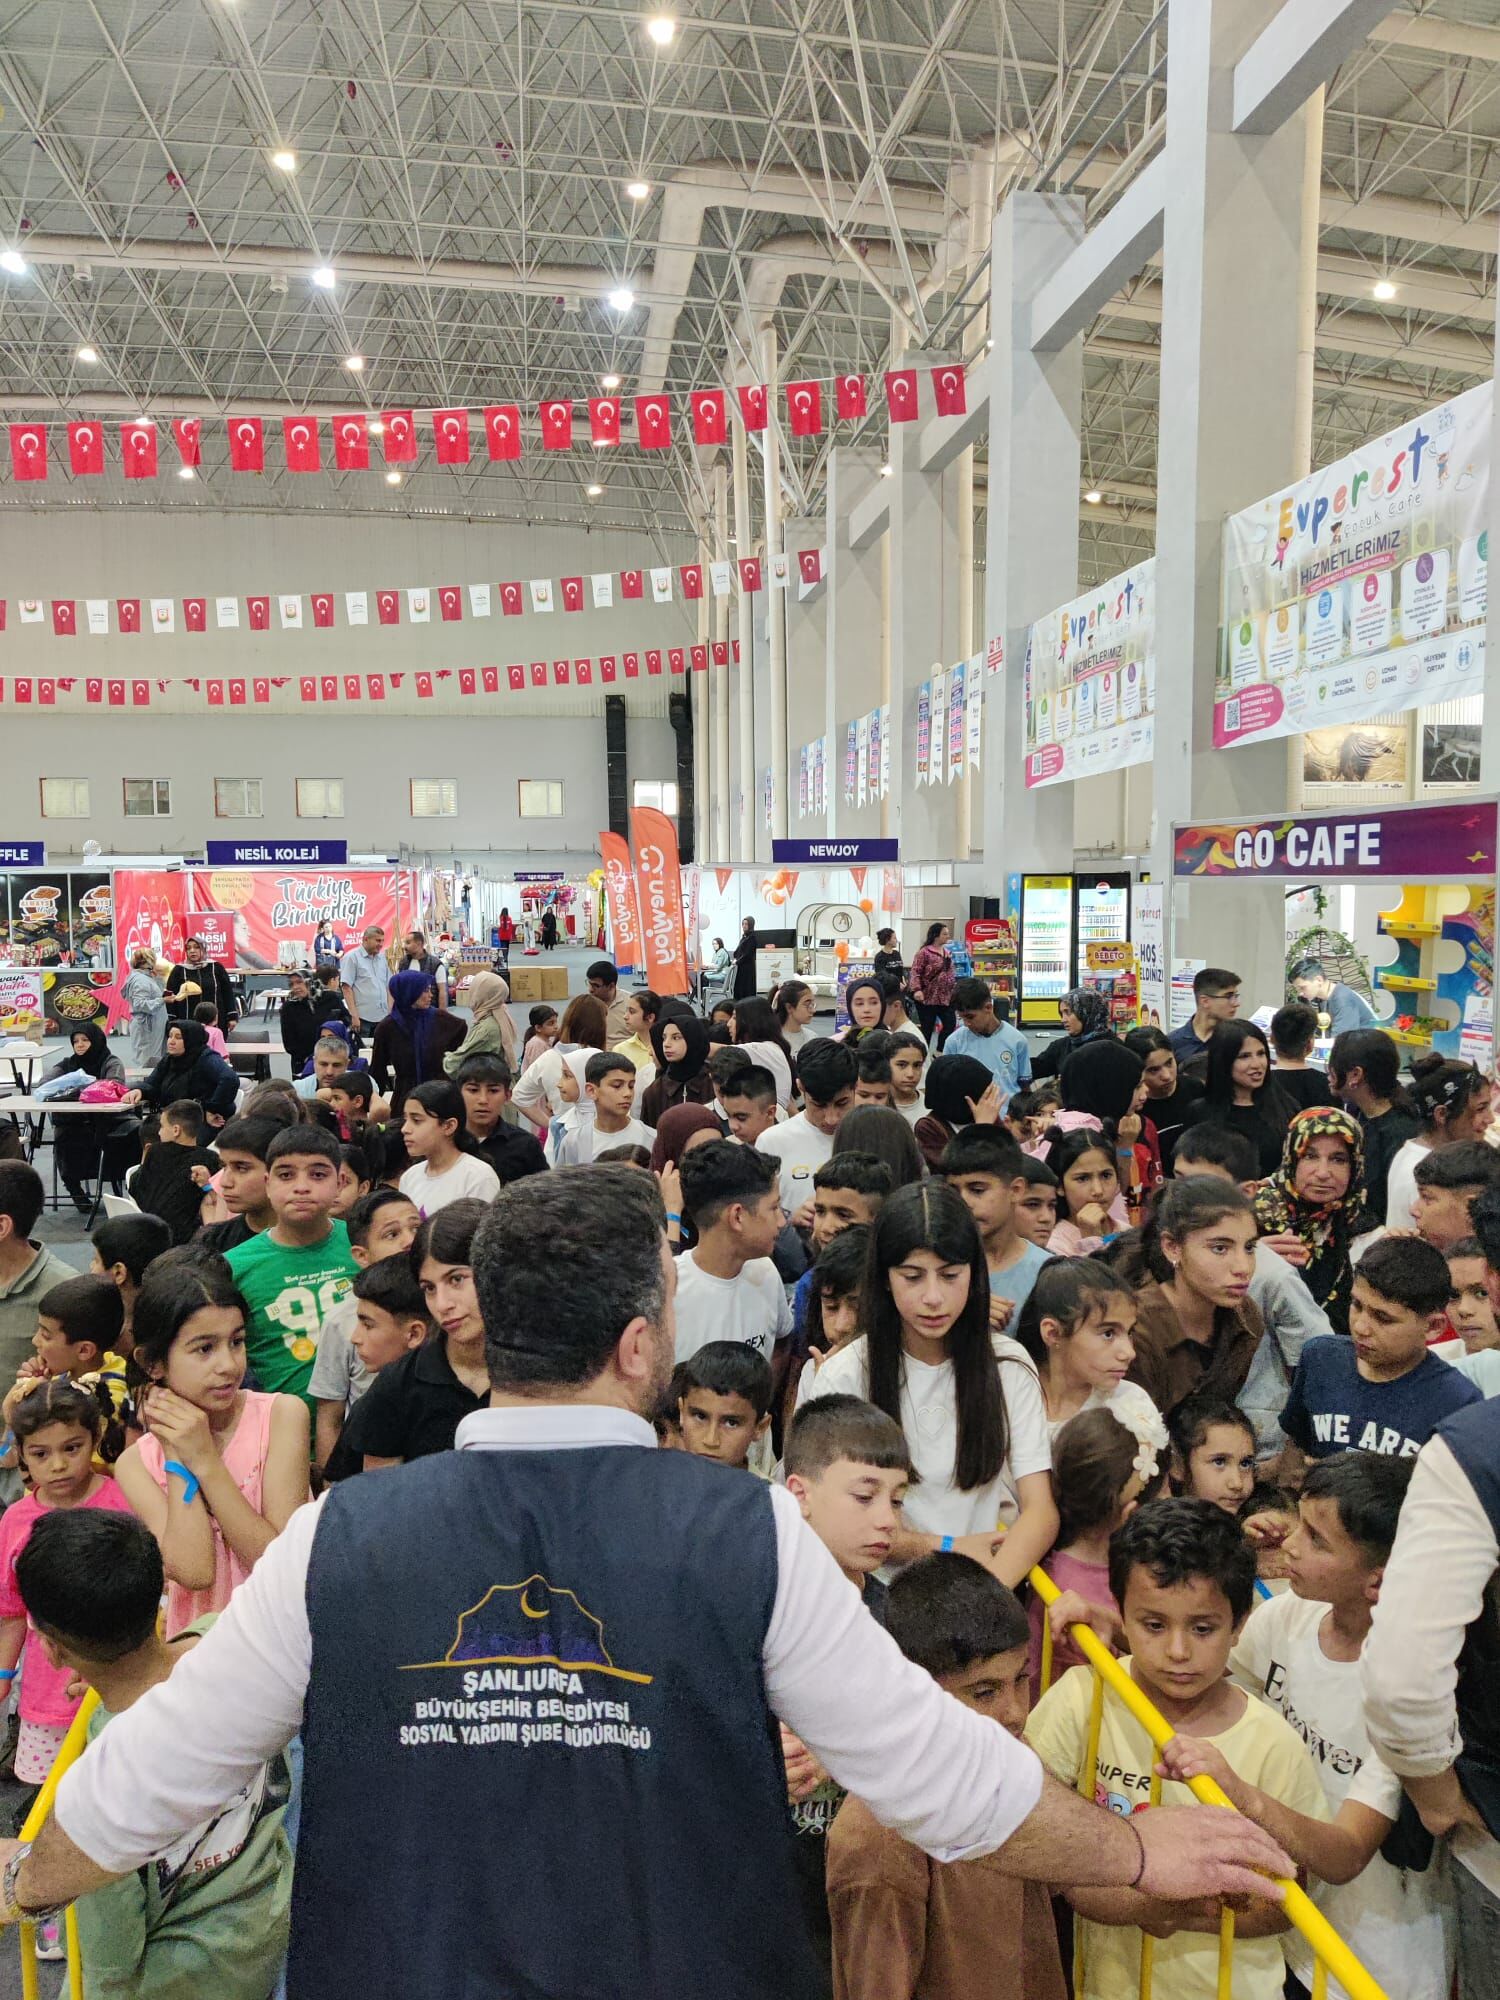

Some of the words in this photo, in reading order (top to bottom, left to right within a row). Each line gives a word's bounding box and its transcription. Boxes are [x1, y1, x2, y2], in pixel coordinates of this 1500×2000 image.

[1279, 427, 1430, 544] Evperest
[1300, 530, 1401, 585] HİZMETLERİMİZ
[235, 846, 272, 860] NESİL
[275, 845, 319, 860] KOLEJİ
[809, 845, 859, 857] NEWJOY
[1234, 830, 1274, 867] GO
[1286, 823, 1381, 867] CAFE
[275, 875, 353, 902] Türkiye
[272, 894, 366, 928] Birinciliği
[204, 943, 224, 952] oleji
[1094, 951, 1125, 961] BEBETO
[1140, 944, 1157, 967] HOŞ
[1140, 967, 1164, 982] ELDİNİZ!
[16, 995, 34, 1006] 250
[1312, 1414, 1350, 1443] WE
[1358, 1421, 1421, 1457] ARE
[463, 1668, 583, 1698] ŞANLIURFA
[415, 1697, 532, 1722] BÜYÜKŞEHİR
[536, 1698, 629, 1722] BELEDİYESİ
[400, 1723, 457, 1745] SOSYAL
[459, 1722, 517, 1745] YARDIM
[521, 1722, 562, 1748] ŞUBE
[195, 1853, 222, 1872] SEE
